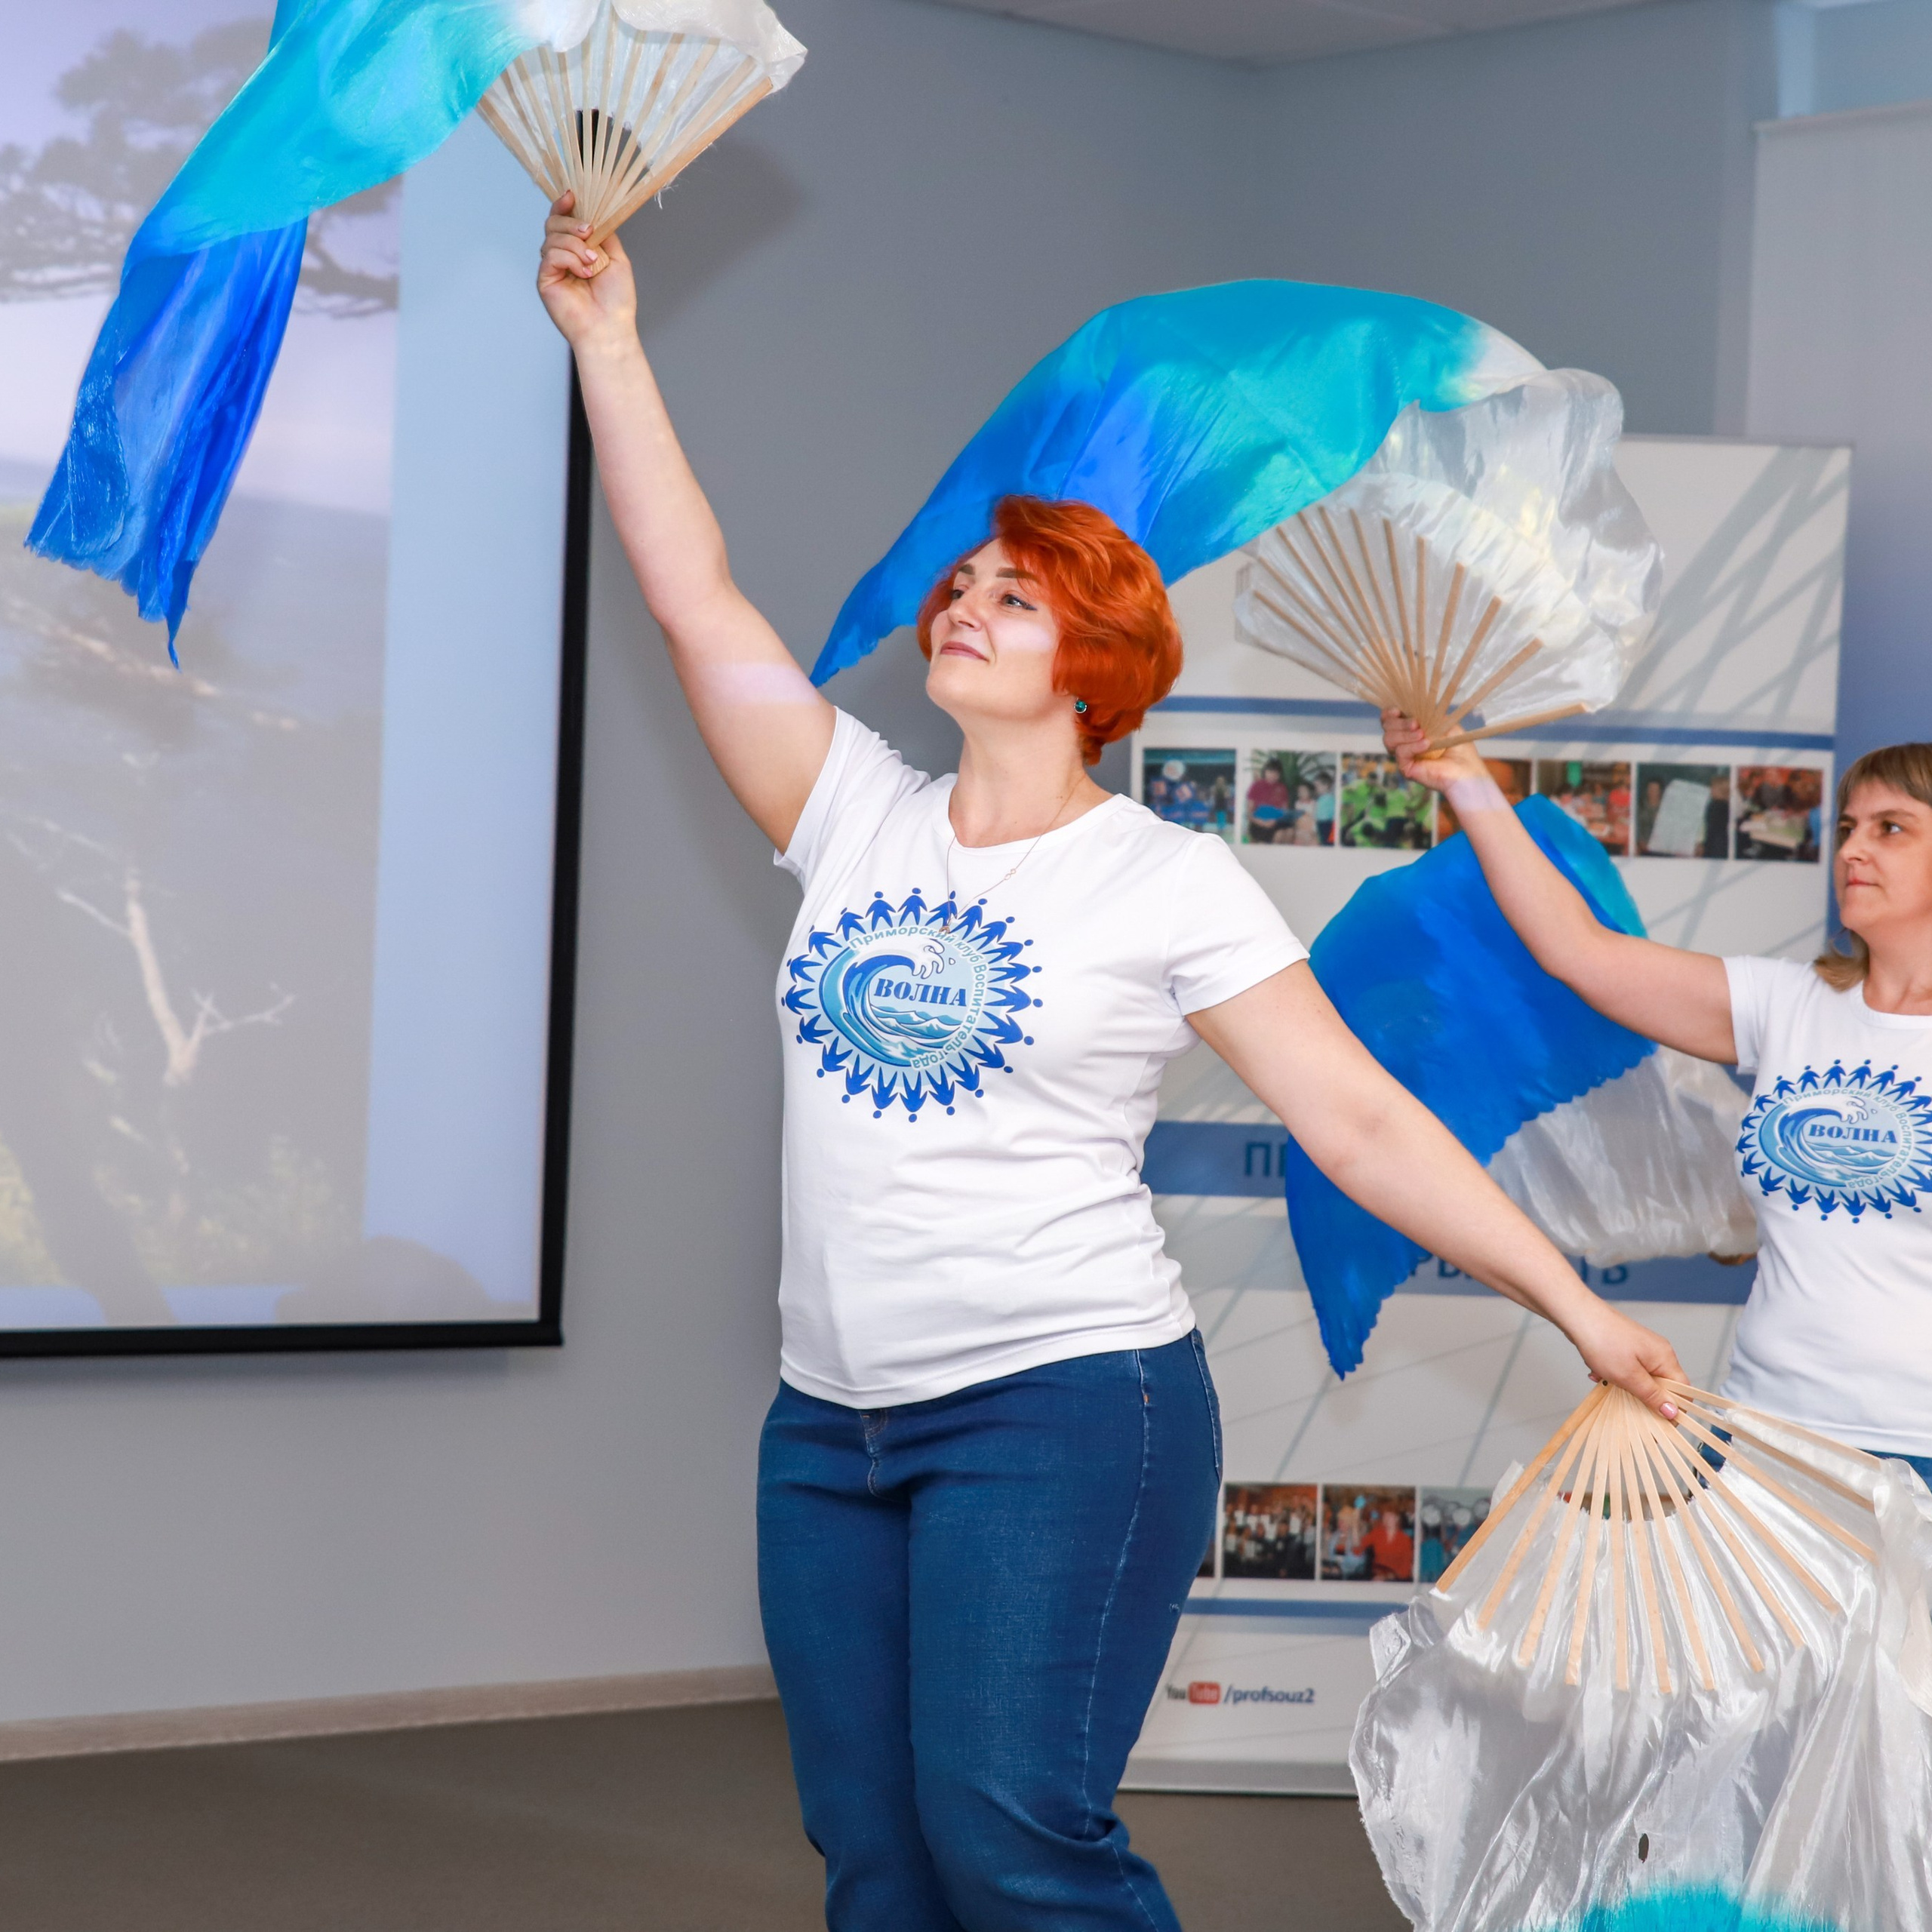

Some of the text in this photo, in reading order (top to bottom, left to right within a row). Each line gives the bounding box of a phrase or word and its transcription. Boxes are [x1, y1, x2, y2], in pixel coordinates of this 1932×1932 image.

[849, 926, 987, 1069] Приморский клуб Воспитатель года
[874, 978, 967, 1007] ВОЛНА
[1808, 1124, 1897, 1143] ВОЛНА
[1224, 1684, 1315, 1706] /profsouz2
